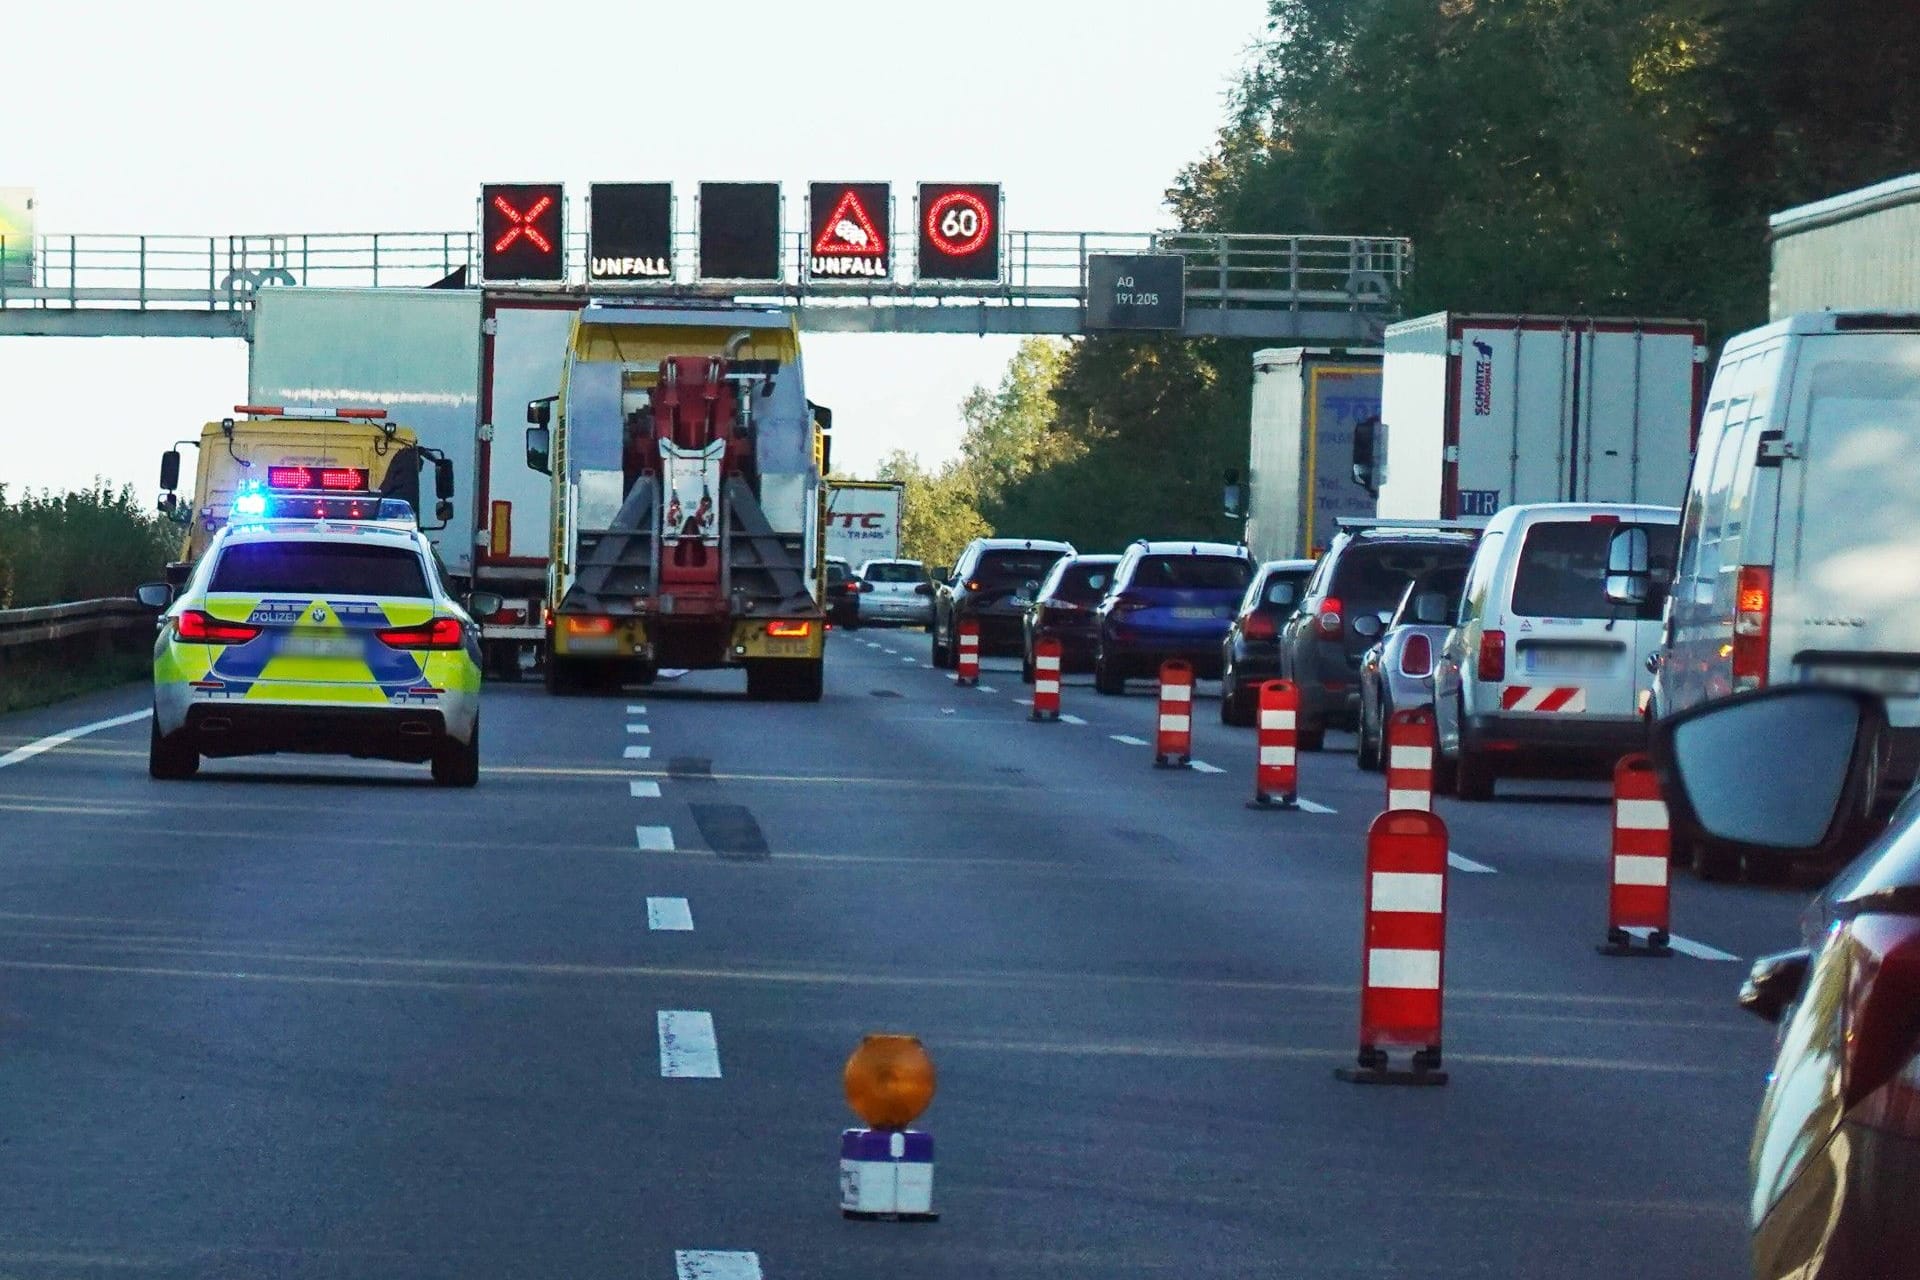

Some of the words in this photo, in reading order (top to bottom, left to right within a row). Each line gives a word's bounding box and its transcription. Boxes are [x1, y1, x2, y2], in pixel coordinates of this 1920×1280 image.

[942, 208, 978, 238] 60
[592, 256, 669, 276] UNFALL
[811, 256, 887, 276] UNFALL
[1116, 276, 1135, 288] AQ
[1475, 360, 1485, 416] SCHMITZ
[1461, 491, 1495, 515] TIR
[251, 611, 297, 623] POLIZEI
